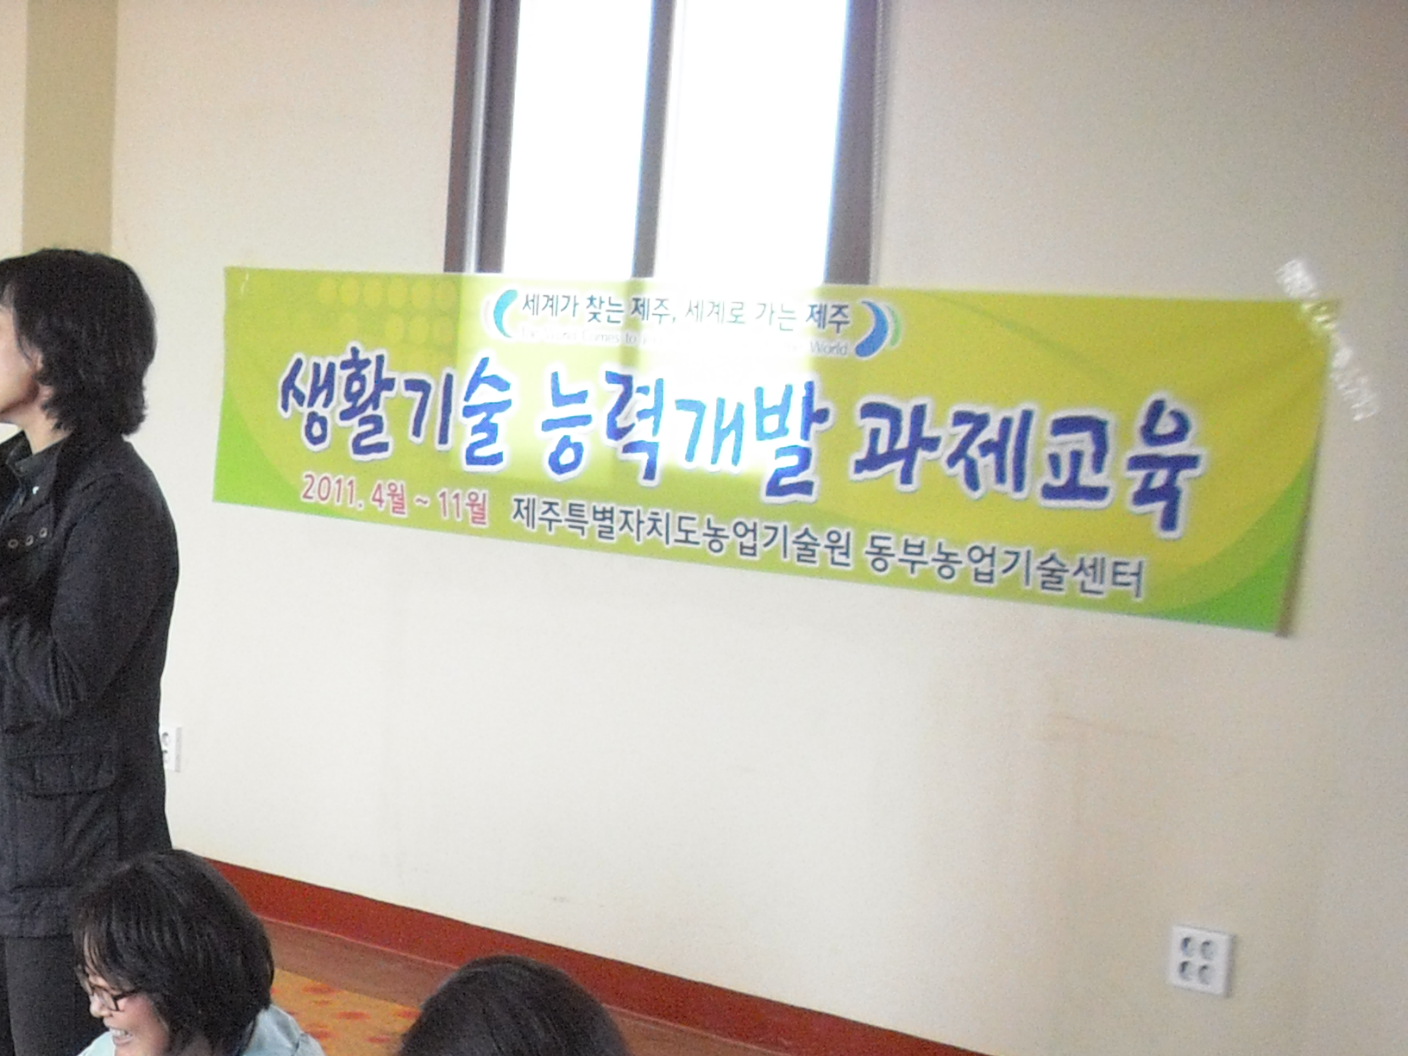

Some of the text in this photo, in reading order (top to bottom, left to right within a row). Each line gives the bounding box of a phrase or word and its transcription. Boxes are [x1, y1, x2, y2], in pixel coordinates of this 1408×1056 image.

[522, 293, 851, 334] 세계가 찾는 제주, 세계로 가는 제주
[279, 345, 1200, 532] 생활기술 능력개발 과제교육
[302, 473, 364, 509] 2011.
[371, 481, 407, 515] 4월
[438, 490, 488, 526] 11월
[511, 495, 853, 568] 제주특별자치도농업기술원
[864, 532, 1145, 599] 동부농업기술센터
